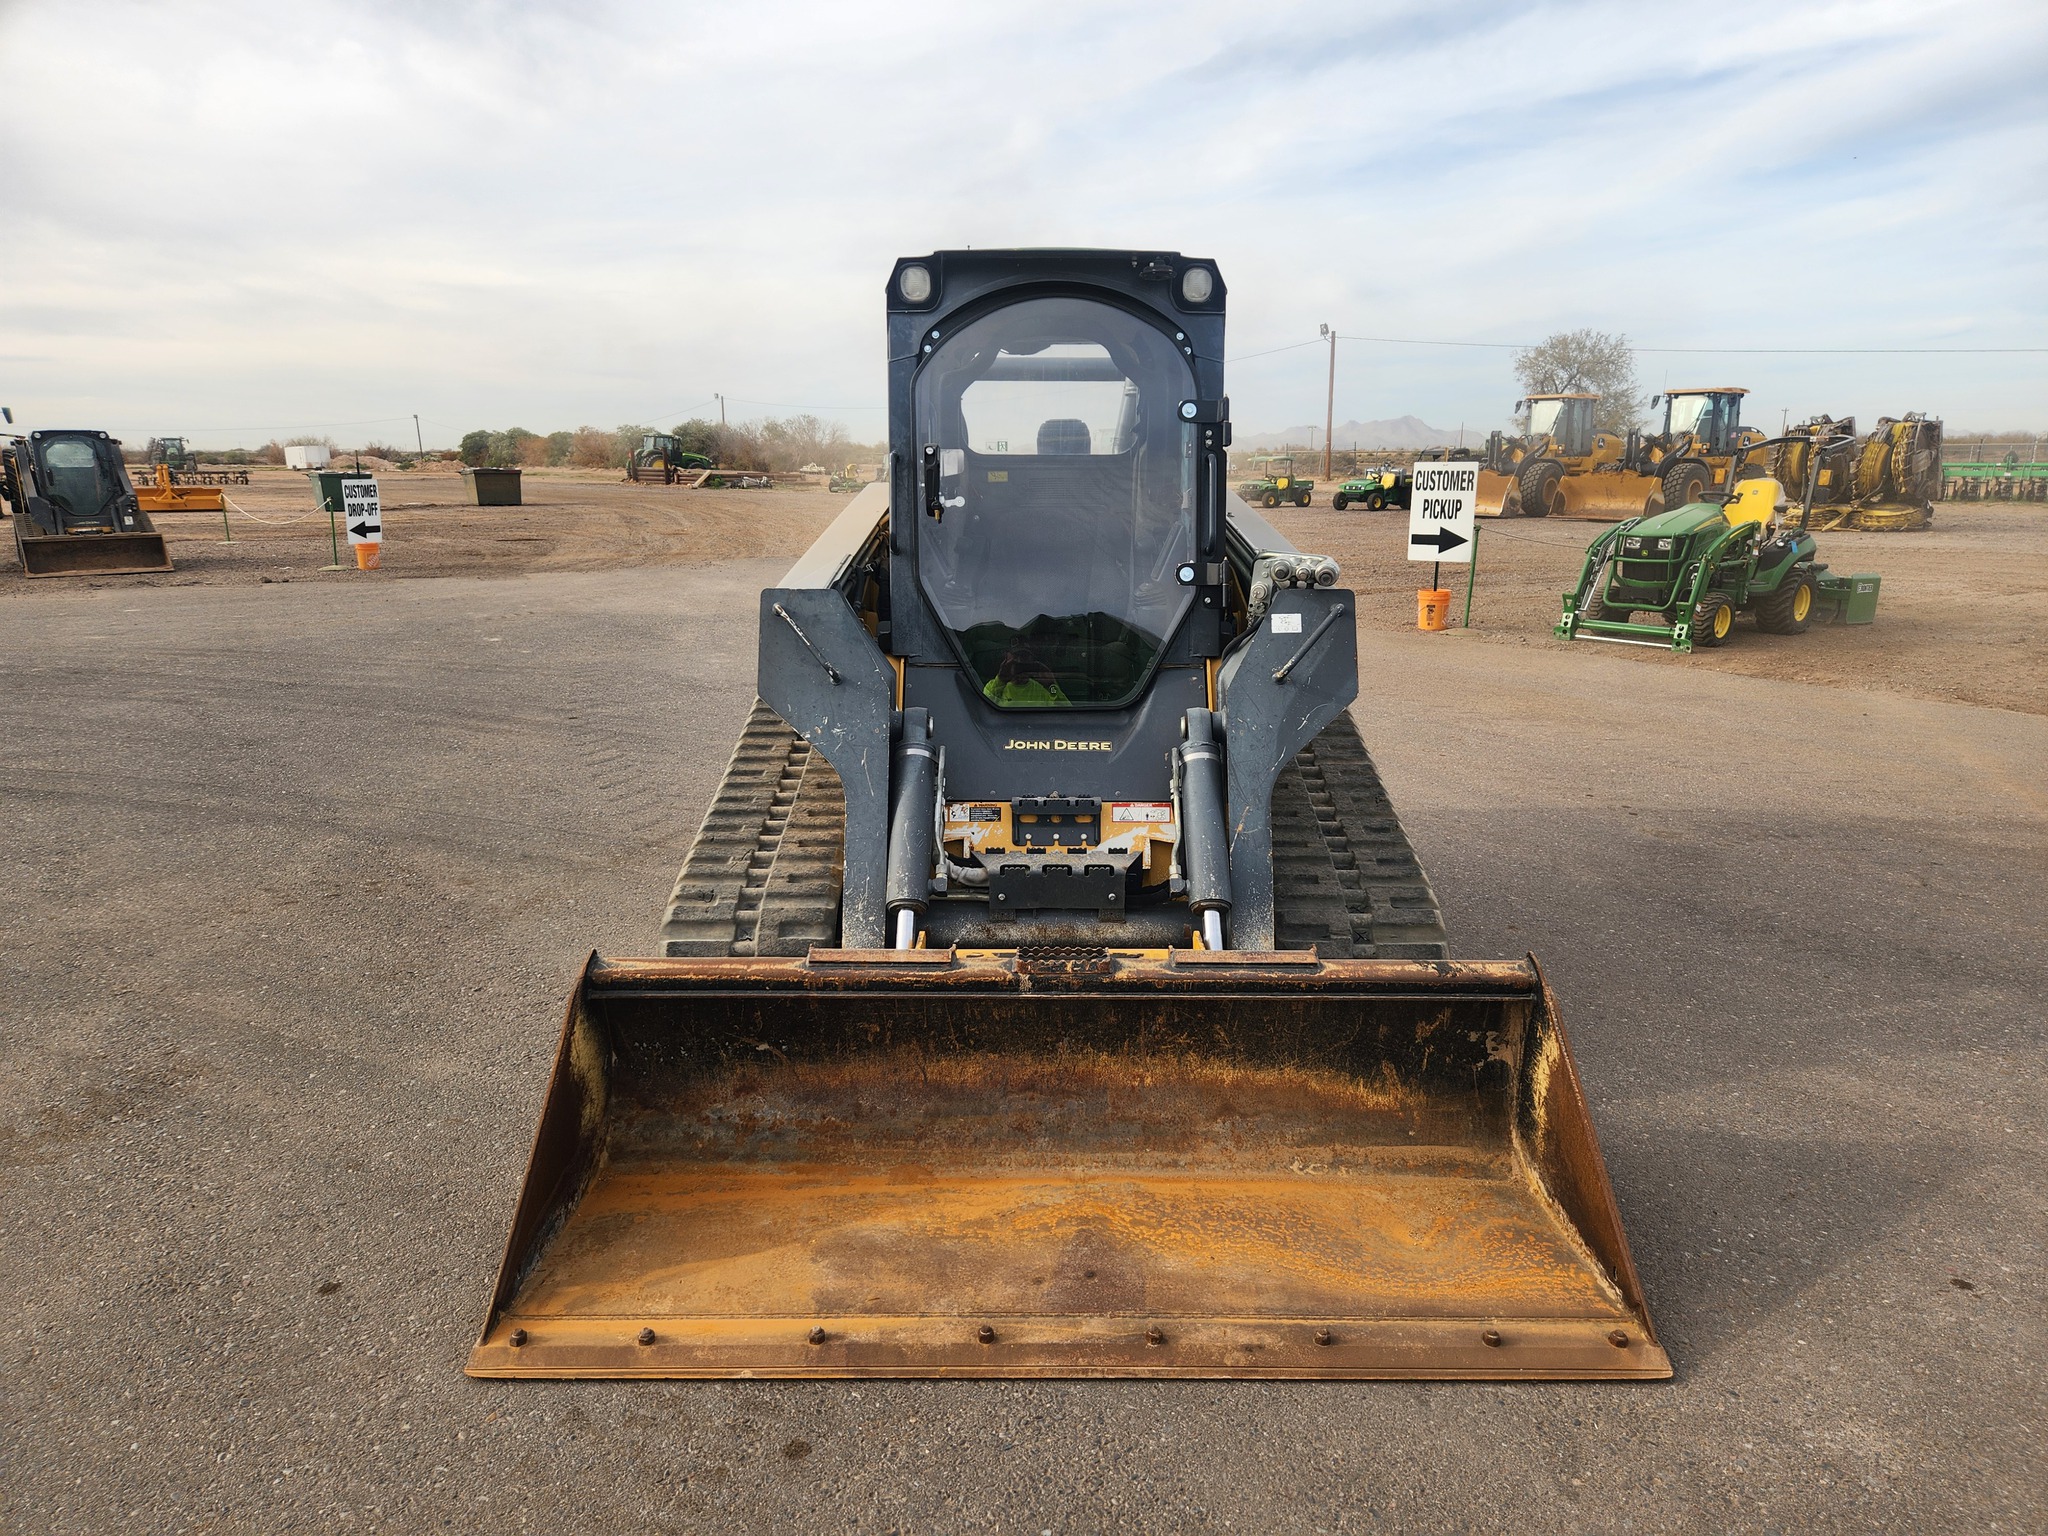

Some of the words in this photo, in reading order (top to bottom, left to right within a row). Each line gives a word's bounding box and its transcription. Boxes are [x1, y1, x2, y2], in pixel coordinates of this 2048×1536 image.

[1415, 470, 1475, 491] CUSTOMER
[344, 485, 378, 498] CUSTOMER
[347, 502, 378, 517] DROP-OFF
[1422, 499, 1462, 519] PICKUP
[1004, 739, 1050, 750] JOHN
[1054, 740, 1111, 751] DEERE
